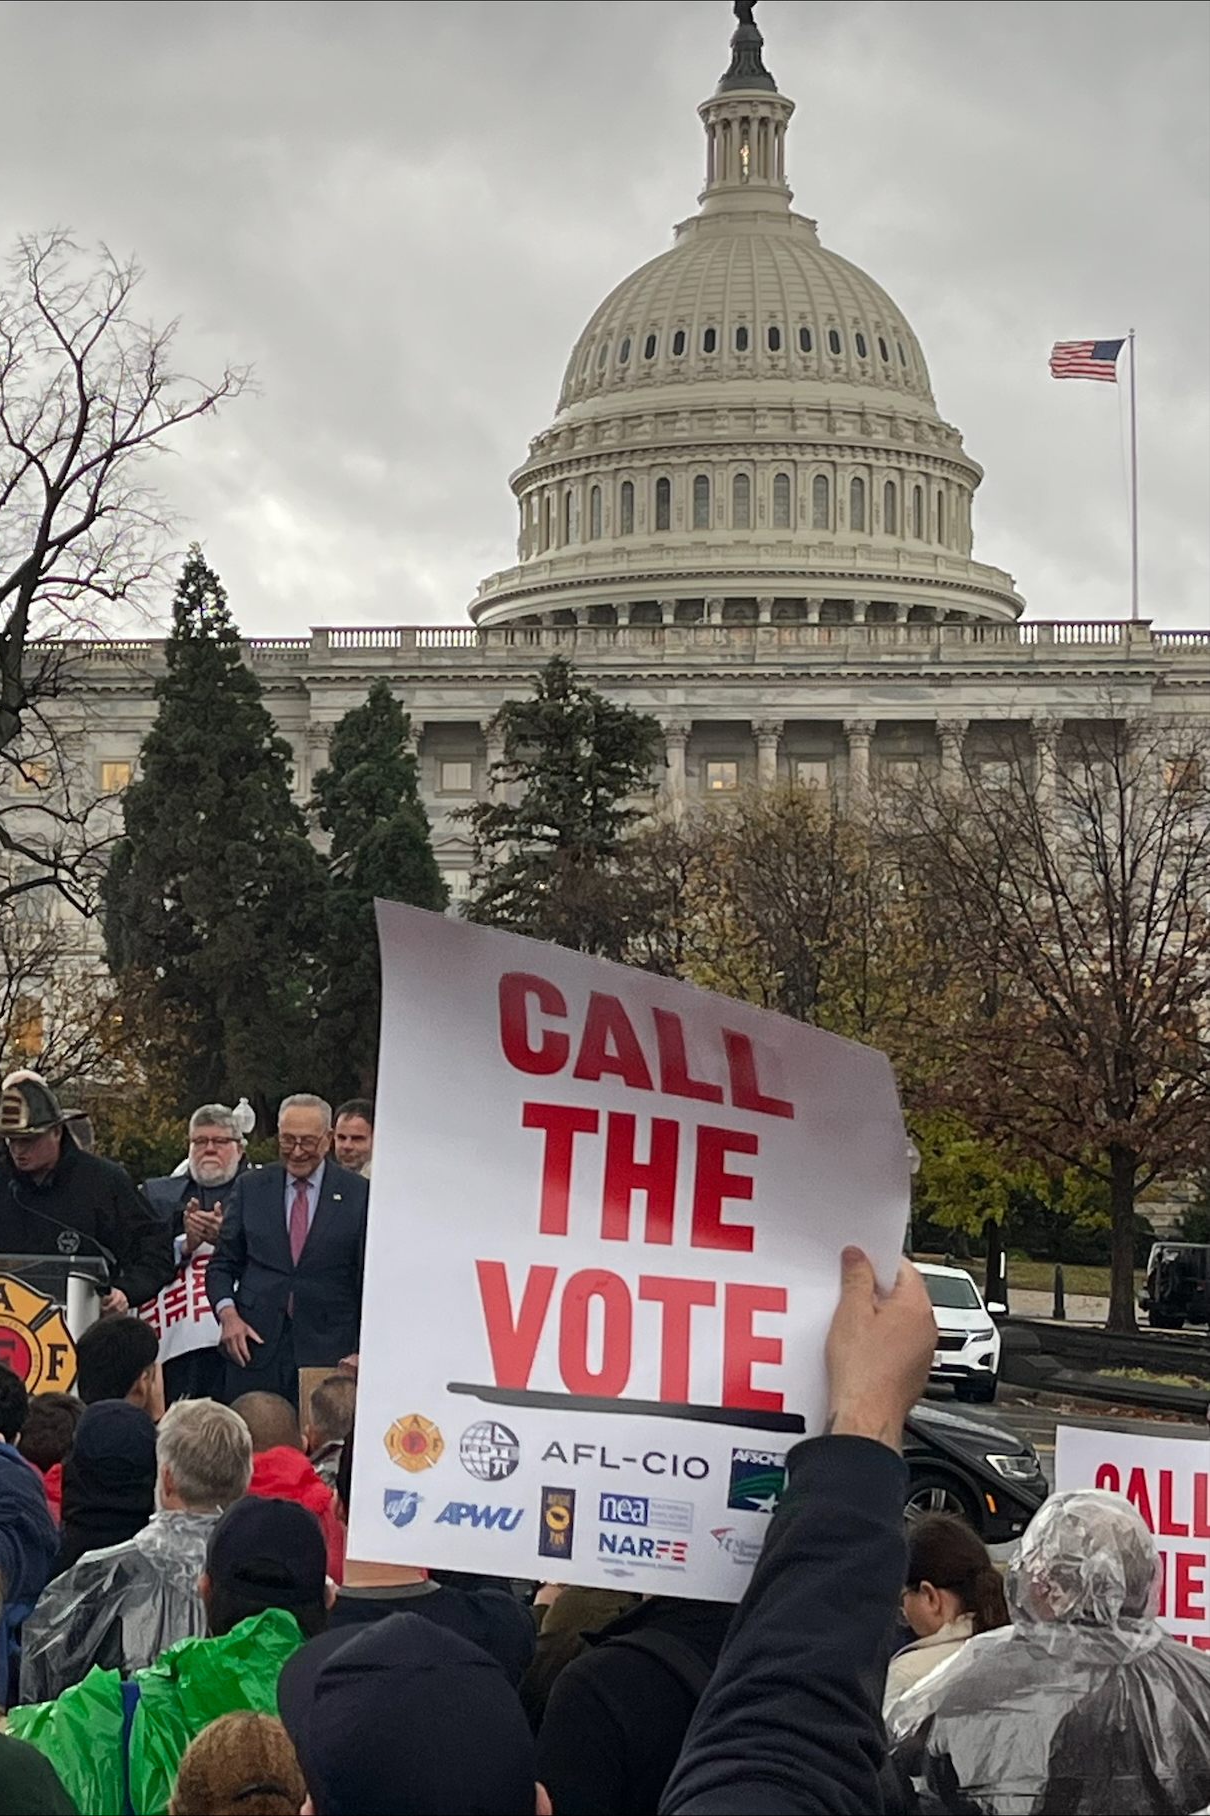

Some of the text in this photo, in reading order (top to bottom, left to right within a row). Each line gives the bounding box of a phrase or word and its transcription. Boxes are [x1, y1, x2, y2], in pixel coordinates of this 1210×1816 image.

[498, 970, 794, 1119] CALL
[522, 1101, 758, 1252] THE
[475, 1259, 788, 1413] VOTE
[541, 1440, 709, 1480] AFL-CIO
[434, 1501, 525, 1531] APWU
[603, 1497, 646, 1523] nea
[598, 1532, 689, 1563] NARFE
